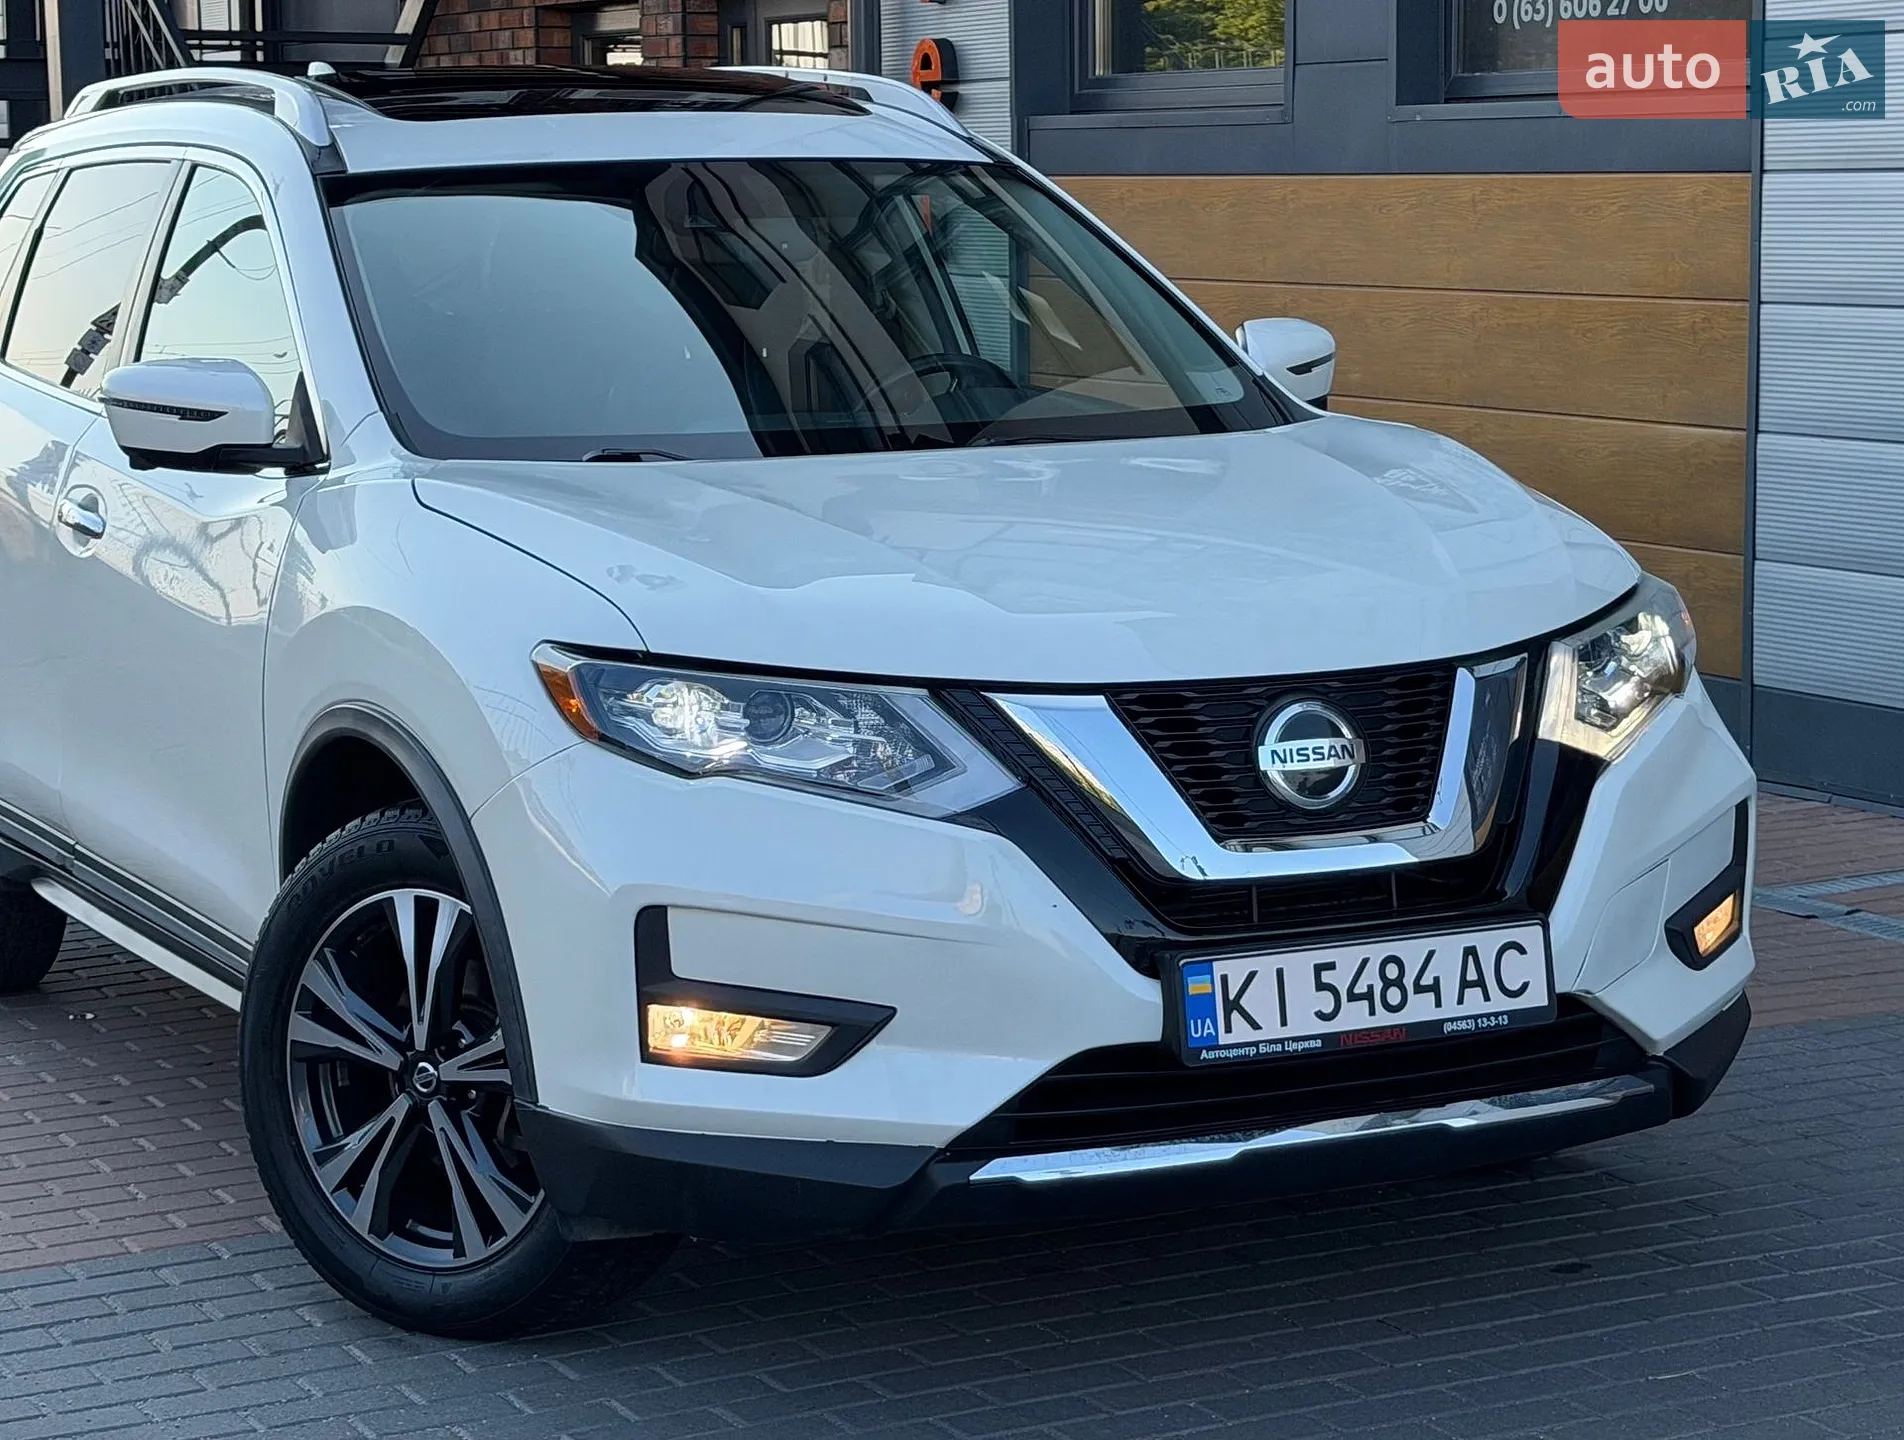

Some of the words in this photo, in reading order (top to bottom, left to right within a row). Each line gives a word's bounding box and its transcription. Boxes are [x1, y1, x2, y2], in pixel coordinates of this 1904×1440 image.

[1270, 743, 1356, 765] NISSAN
[1219, 966, 1289, 1034] KI
[1312, 949, 1444, 1022] 5484
[1456, 939, 1532, 1007] AC
[1190, 1018, 1217, 1039] UA
[1476, 1014, 1509, 1029] 13-3-13
[1339, 1026, 1408, 1047] NISSAN
[1199, 1045, 1257, 1060] Автоцентр
[1258, 1042, 1283, 1054] Біла
[1284, 1038, 1322, 1053] Церква
